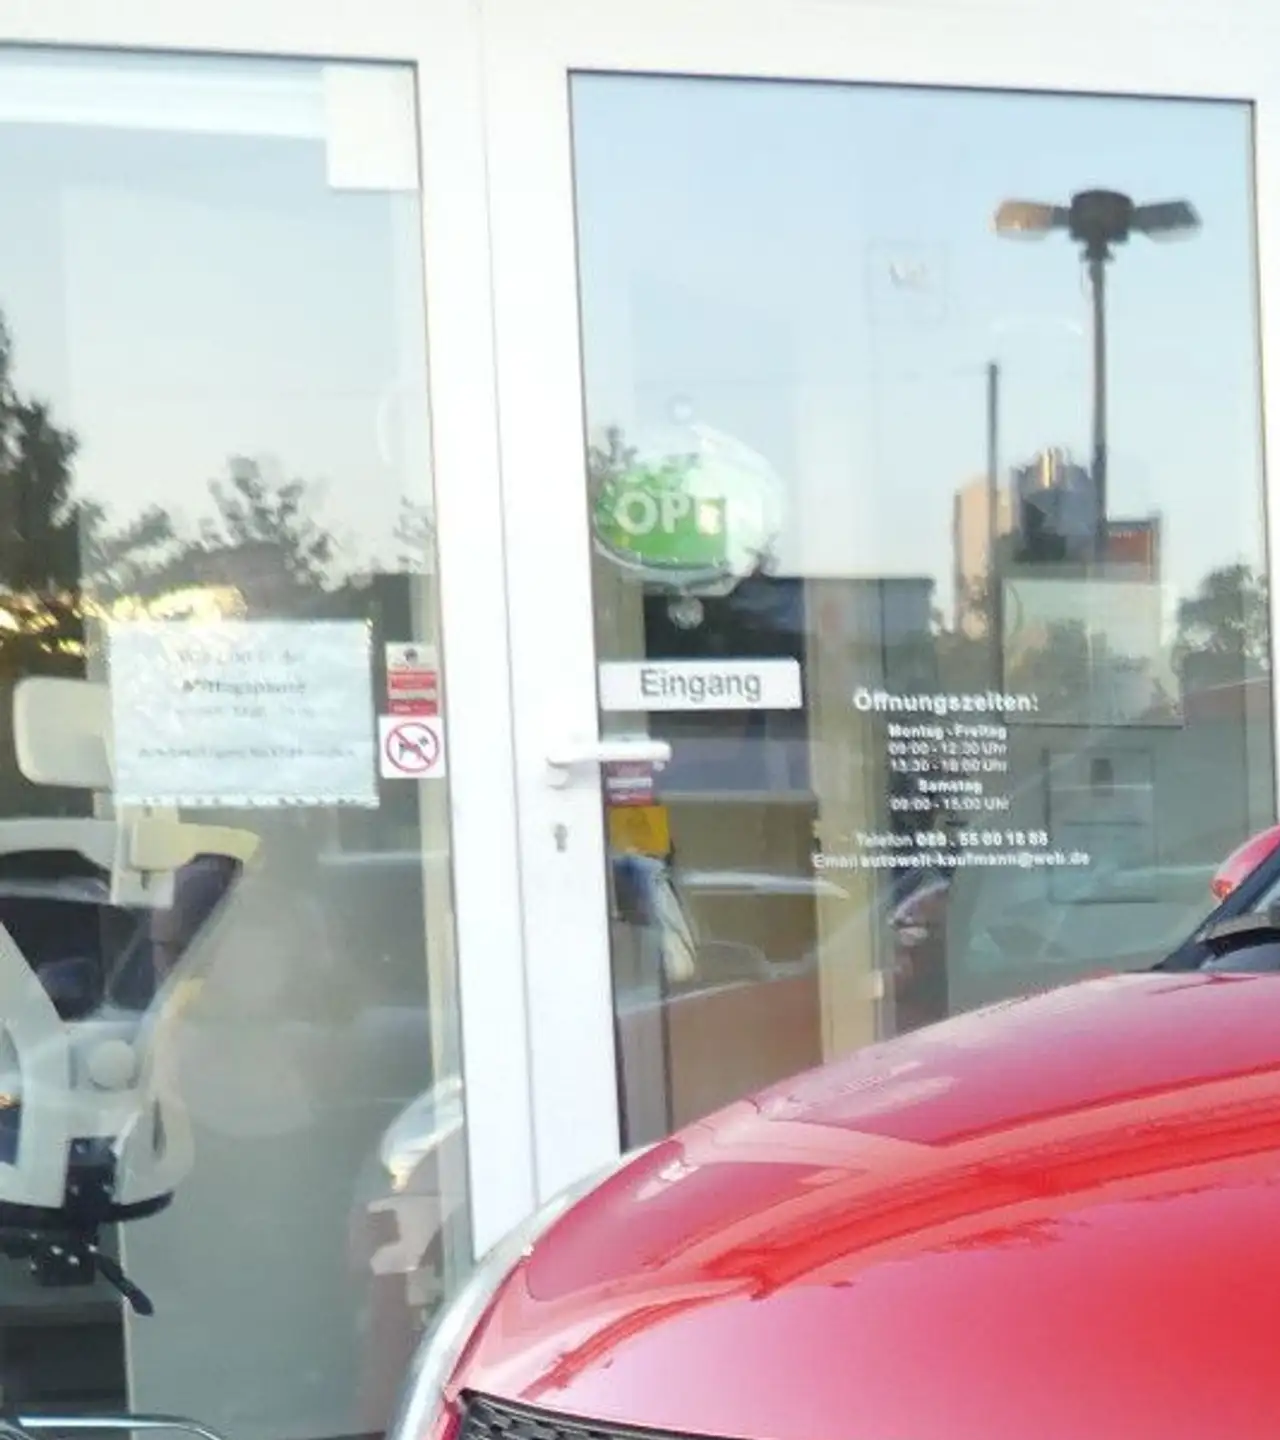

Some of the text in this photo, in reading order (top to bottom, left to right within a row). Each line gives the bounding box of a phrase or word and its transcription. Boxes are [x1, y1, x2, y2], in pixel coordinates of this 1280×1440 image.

[613, 491, 762, 535] OPE
[640, 669, 762, 702] Eingang
[853, 687, 1038, 715] Öffnungszeiten:
[888, 724, 944, 740] Montag
[954, 723, 1007, 740] Freitag
[981, 741, 1007, 756] Uhr
[982, 757, 1007, 773] Uhr
[918, 779, 983, 795] Samstag
[983, 796, 1010, 811] Uhr
[856, 831, 913, 847] Telefon
